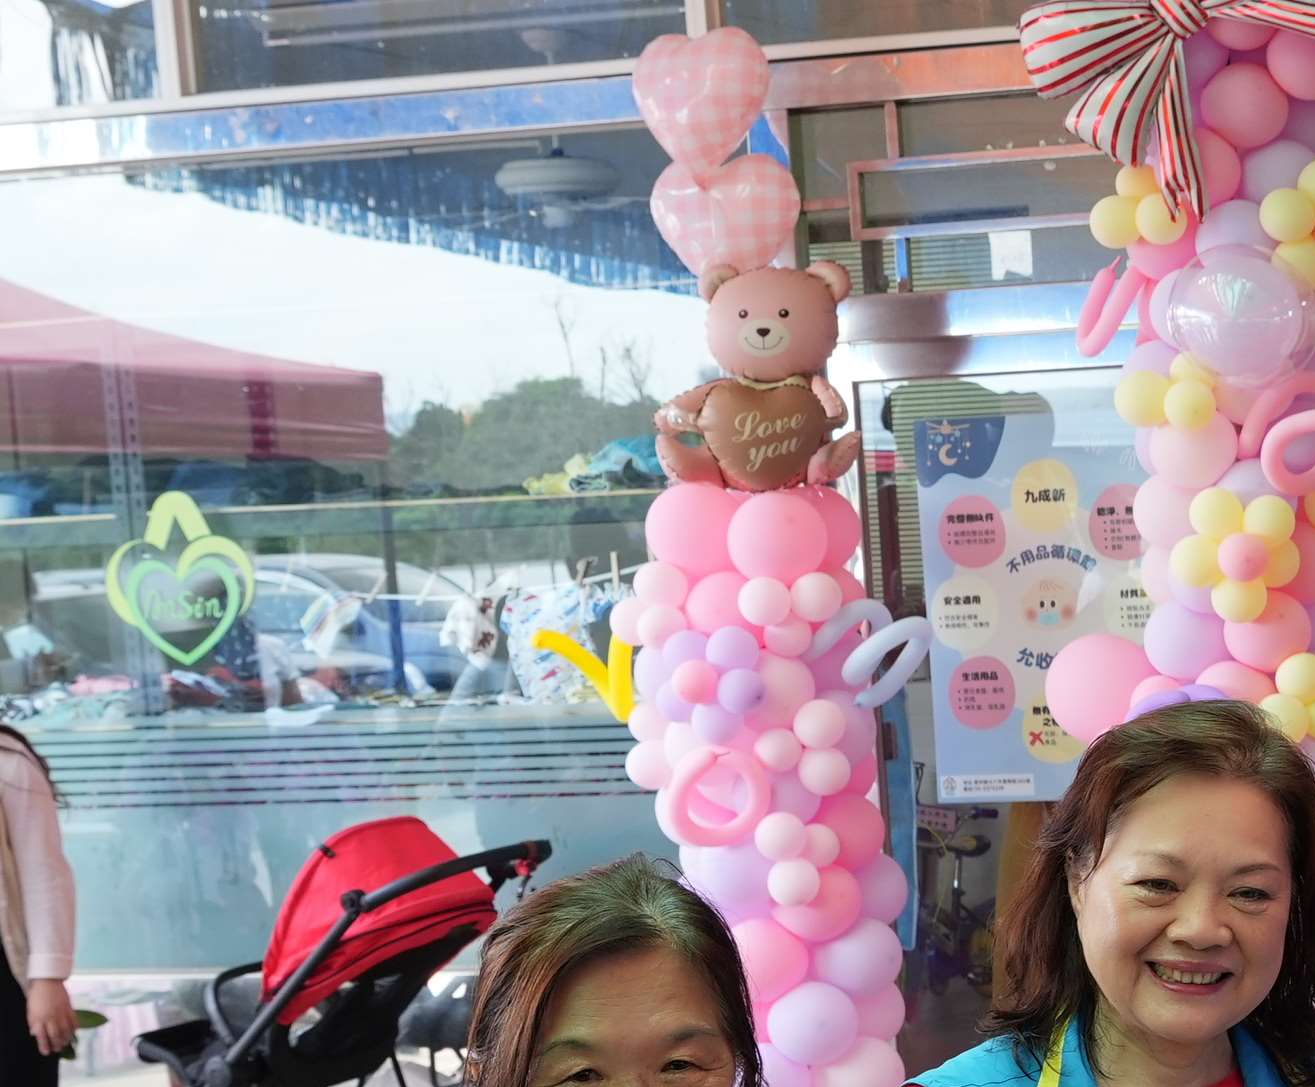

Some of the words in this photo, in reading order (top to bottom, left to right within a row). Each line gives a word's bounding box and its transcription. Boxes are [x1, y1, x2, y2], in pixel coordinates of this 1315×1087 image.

[731, 411, 807, 443] Love
[745, 434, 803, 474] you
[1024, 487, 1067, 504] 九成新
